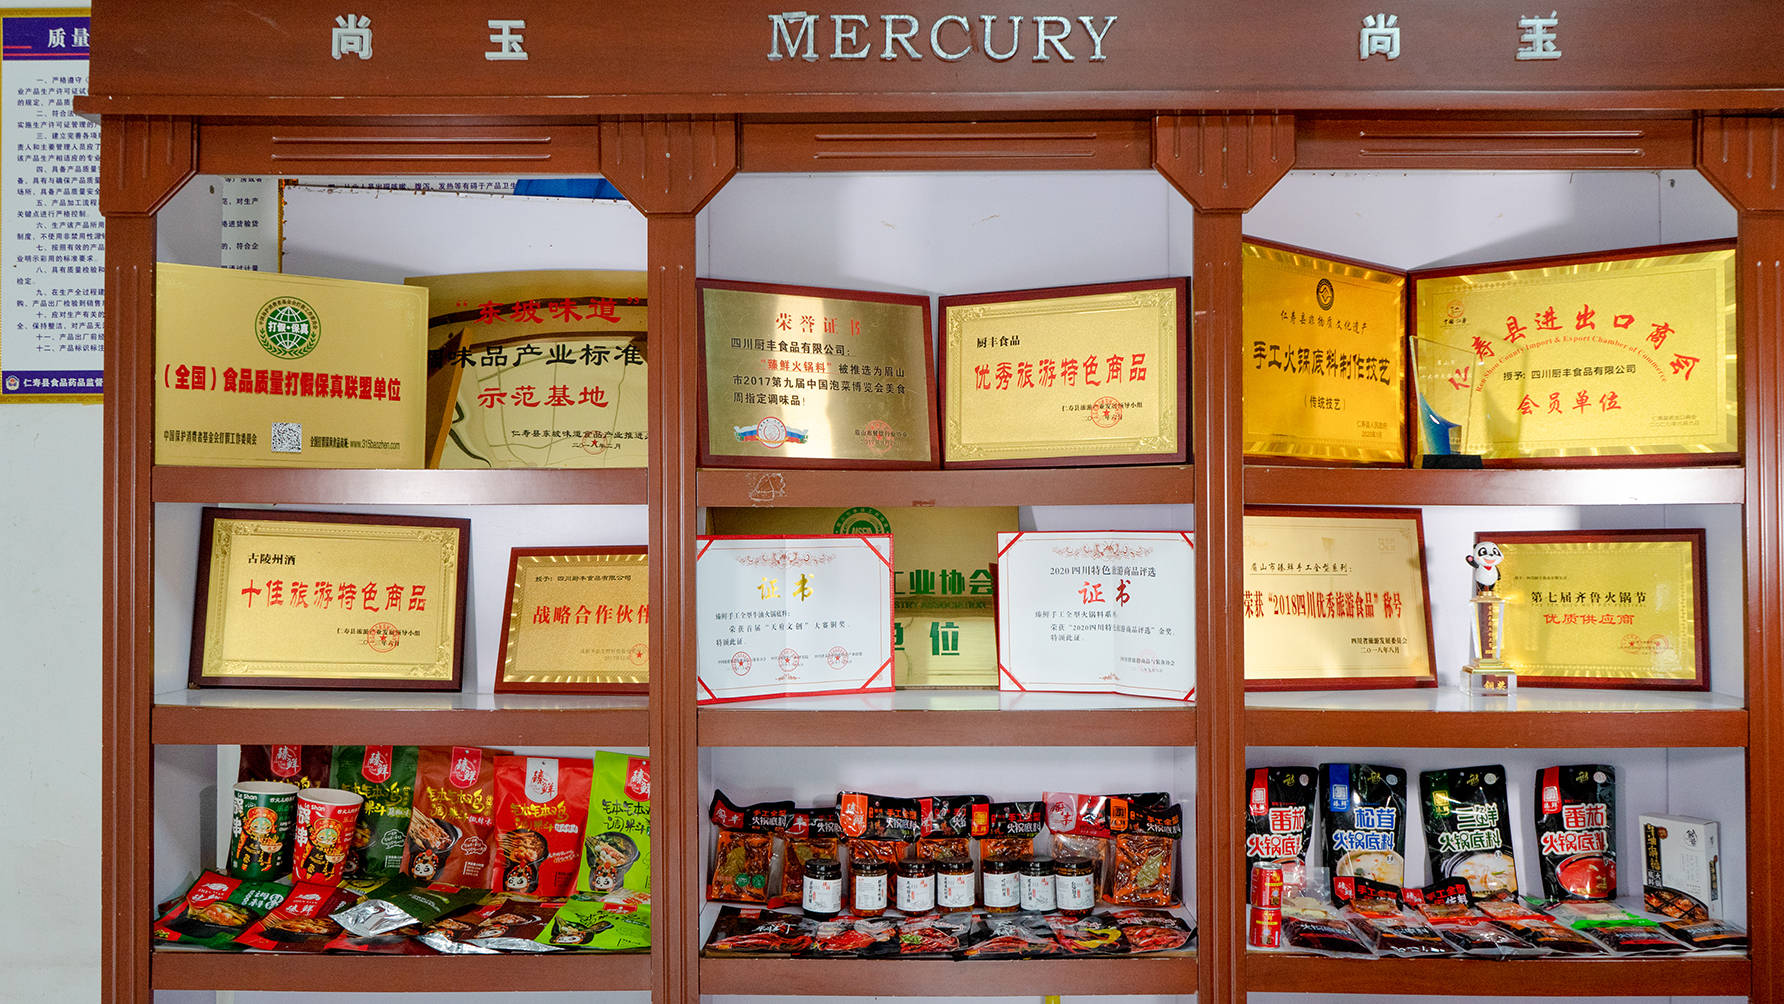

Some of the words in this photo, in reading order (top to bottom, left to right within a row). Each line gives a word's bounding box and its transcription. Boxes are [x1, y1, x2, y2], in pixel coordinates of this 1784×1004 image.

[47, 27, 90, 48] 质量
[330, 13, 373, 60] 尚
[486, 19, 529, 62] 玉
[767, 10, 1117, 63] MERCURY
[1359, 13, 1402, 60] 尚
[36, 132, 100, 140] 三、建立完善各项
[36, 165, 100, 173] 四、具备产品质量
[976, 334, 1021, 349] 厨丰食品
[1525, 338, 1553, 351] Import
[1562, 334, 1591, 344] Export
[1592, 335, 1627, 349] Chamber
[838, 362, 906, 379] 被推选为眉山
[974, 352, 1148, 392] 优秀旅游特色商品
[1252, 340, 1391, 386] 手工火锅底料制作技艺
[1531, 363, 1637, 380] 四川厨丰食品有限公司
[477, 384, 610, 409] 示范基地
[732, 374, 906, 395] 市2017第九届中国泡菜博览会美食
[1516, 389, 1622, 415] 会员单位
[248, 552, 297, 566] 古陵州酒
[240, 579, 428, 613] 十佳旅游特色商品
[756, 573, 816, 602] 证书
[1077, 578, 1131, 608] 证书
[1531, 591, 1648, 604] 第七届齐鲁火锅节
[1543, 613, 1636, 625] 优质供应商
[1354, 807, 1397, 831] 松茸
[1561, 803, 1608, 831] 番茄
[1332, 829, 1395, 851] 火锅底料
[1437, 828, 1503, 853] 火锅底料
[1540, 830, 1609, 855] 火锅底料
